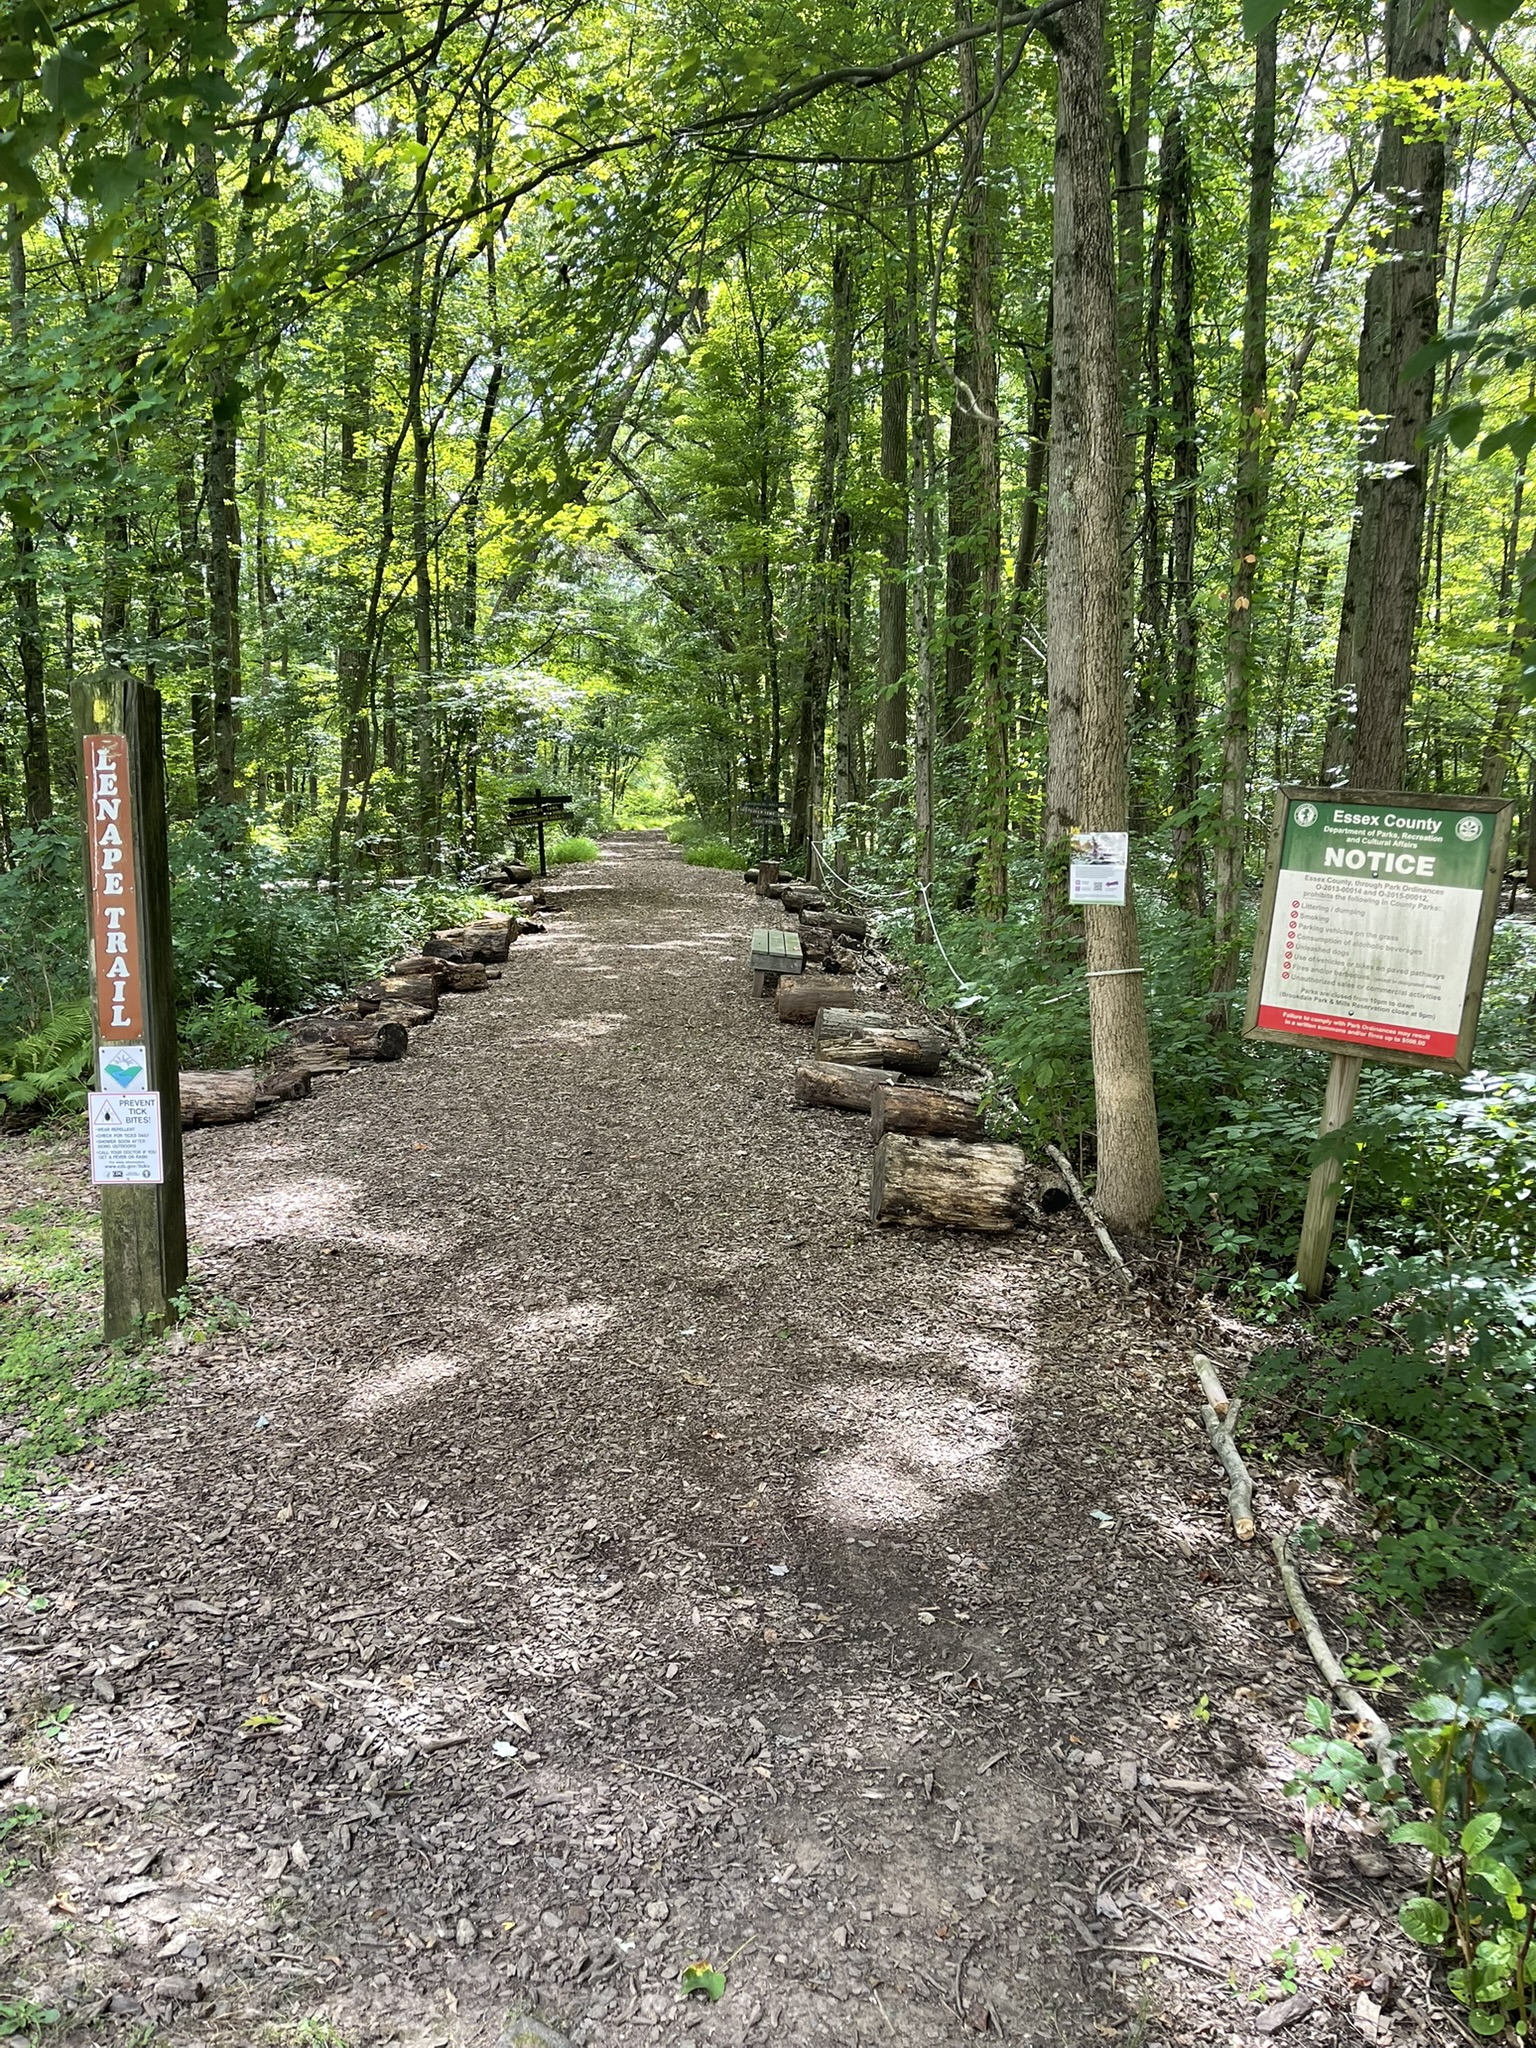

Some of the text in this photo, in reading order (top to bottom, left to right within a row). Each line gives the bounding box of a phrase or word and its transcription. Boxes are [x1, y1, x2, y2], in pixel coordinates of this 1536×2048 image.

[1333, 810, 1380, 826] Essex
[1384, 814, 1442, 834] County
[1324, 826, 1366, 836] Department
[1376, 830, 1400, 839] Parks,
[1402, 832, 1443, 842] Recreation
[1362, 838, 1391, 846] Cultural
[1392, 841, 1418, 849] Affairs
[1324, 847, 1436, 876] NOTICE
[96, 749, 131, 1026] LENAPE TRAIL
[1326, 877, 1353, 887] County,
[1354, 881, 1382, 890] through
[1402, 885, 1444, 895] Ordinances
[1303, 891, 1333, 899] prohibits
[1348, 895, 1380, 906] following
[1390, 900, 1416, 910] County
[1301, 902, 1329, 912] Littering
[1335, 907, 1366, 917] dumping
[1300, 913, 1329, 923] Smoking
[1298, 924, 1324, 933] Parking
[1326, 927, 1353, 936] vehicles
[1366, 931, 1378, 939] the
[1295, 944, 1350, 956] Unleashed dogs
[1296, 934, 1342, 945] Consumption
[1353, 941, 1384, 950] alcoholic
[1385, 944, 1423, 955] beverages
[1292, 964, 1309, 972] Fires
[1334, 970, 1370, 980] barbecues
[1316, 957, 1345, 966] vehicles
[1356, 962, 1374, 970] bikes
[1410, 970, 1445, 980] pathways
[1291, 974, 1336, 986] Unauthorized
[1366, 985, 1407, 996] commercial
[1409, 991, 1441, 1000] activities
[1331, 992, 1352, 1000] closed
[1352, 1002, 1390, 1013] Reservation
[1296, 1021, 1316, 1029] written
[1317, 1025, 1346, 1034] summons
[1311, 1017, 1332, 1025] comply
[1362, 1024, 1396, 1034] Ordinances
